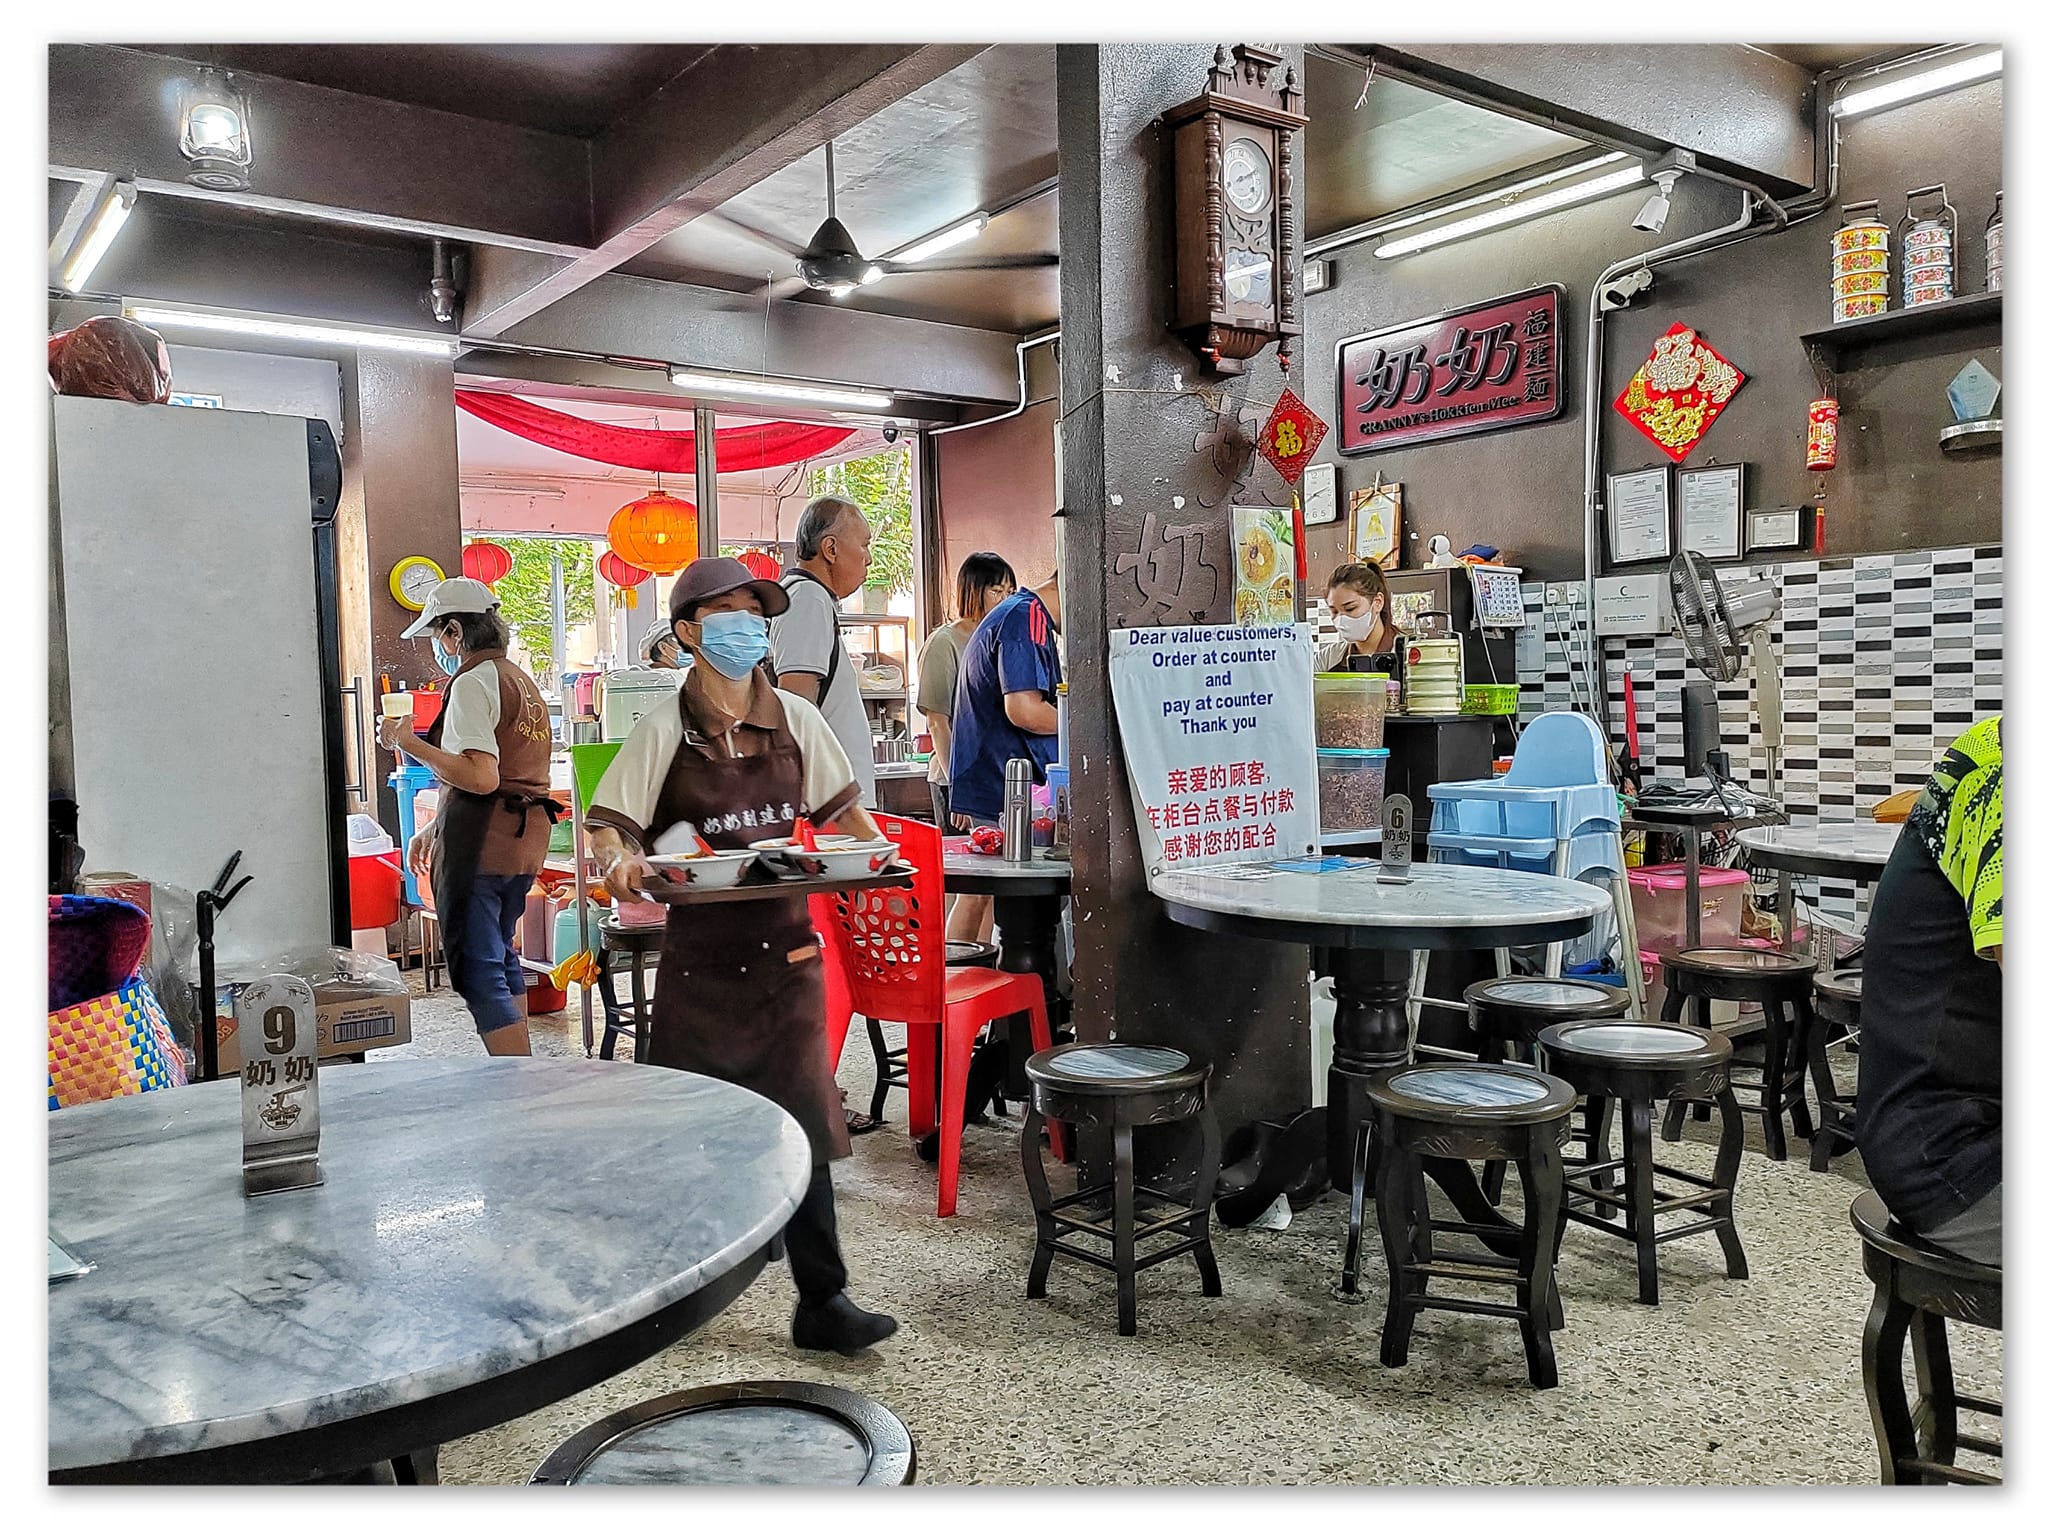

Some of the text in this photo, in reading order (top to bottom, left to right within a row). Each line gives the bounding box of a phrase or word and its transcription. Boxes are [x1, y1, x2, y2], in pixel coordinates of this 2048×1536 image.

[1354, 322, 1518, 414] 奶奶
[1429, 401, 1486, 422] Hokkien
[1129, 625, 1297, 645] Dear value customers,
[1152, 647, 1277, 667] Order at counter
[1205, 671, 1232, 687] and
[1163, 691, 1274, 717] pay at counter
[1180, 715, 1257, 735] Thank you
[1058, 795, 1065, 813] 5
[1391, 807, 1404, 828] 6
[1163, 822, 1278, 862] 感谢您的配合
[263, 1005, 296, 1055] 9
[246, 1055, 314, 1088] 奶奶
